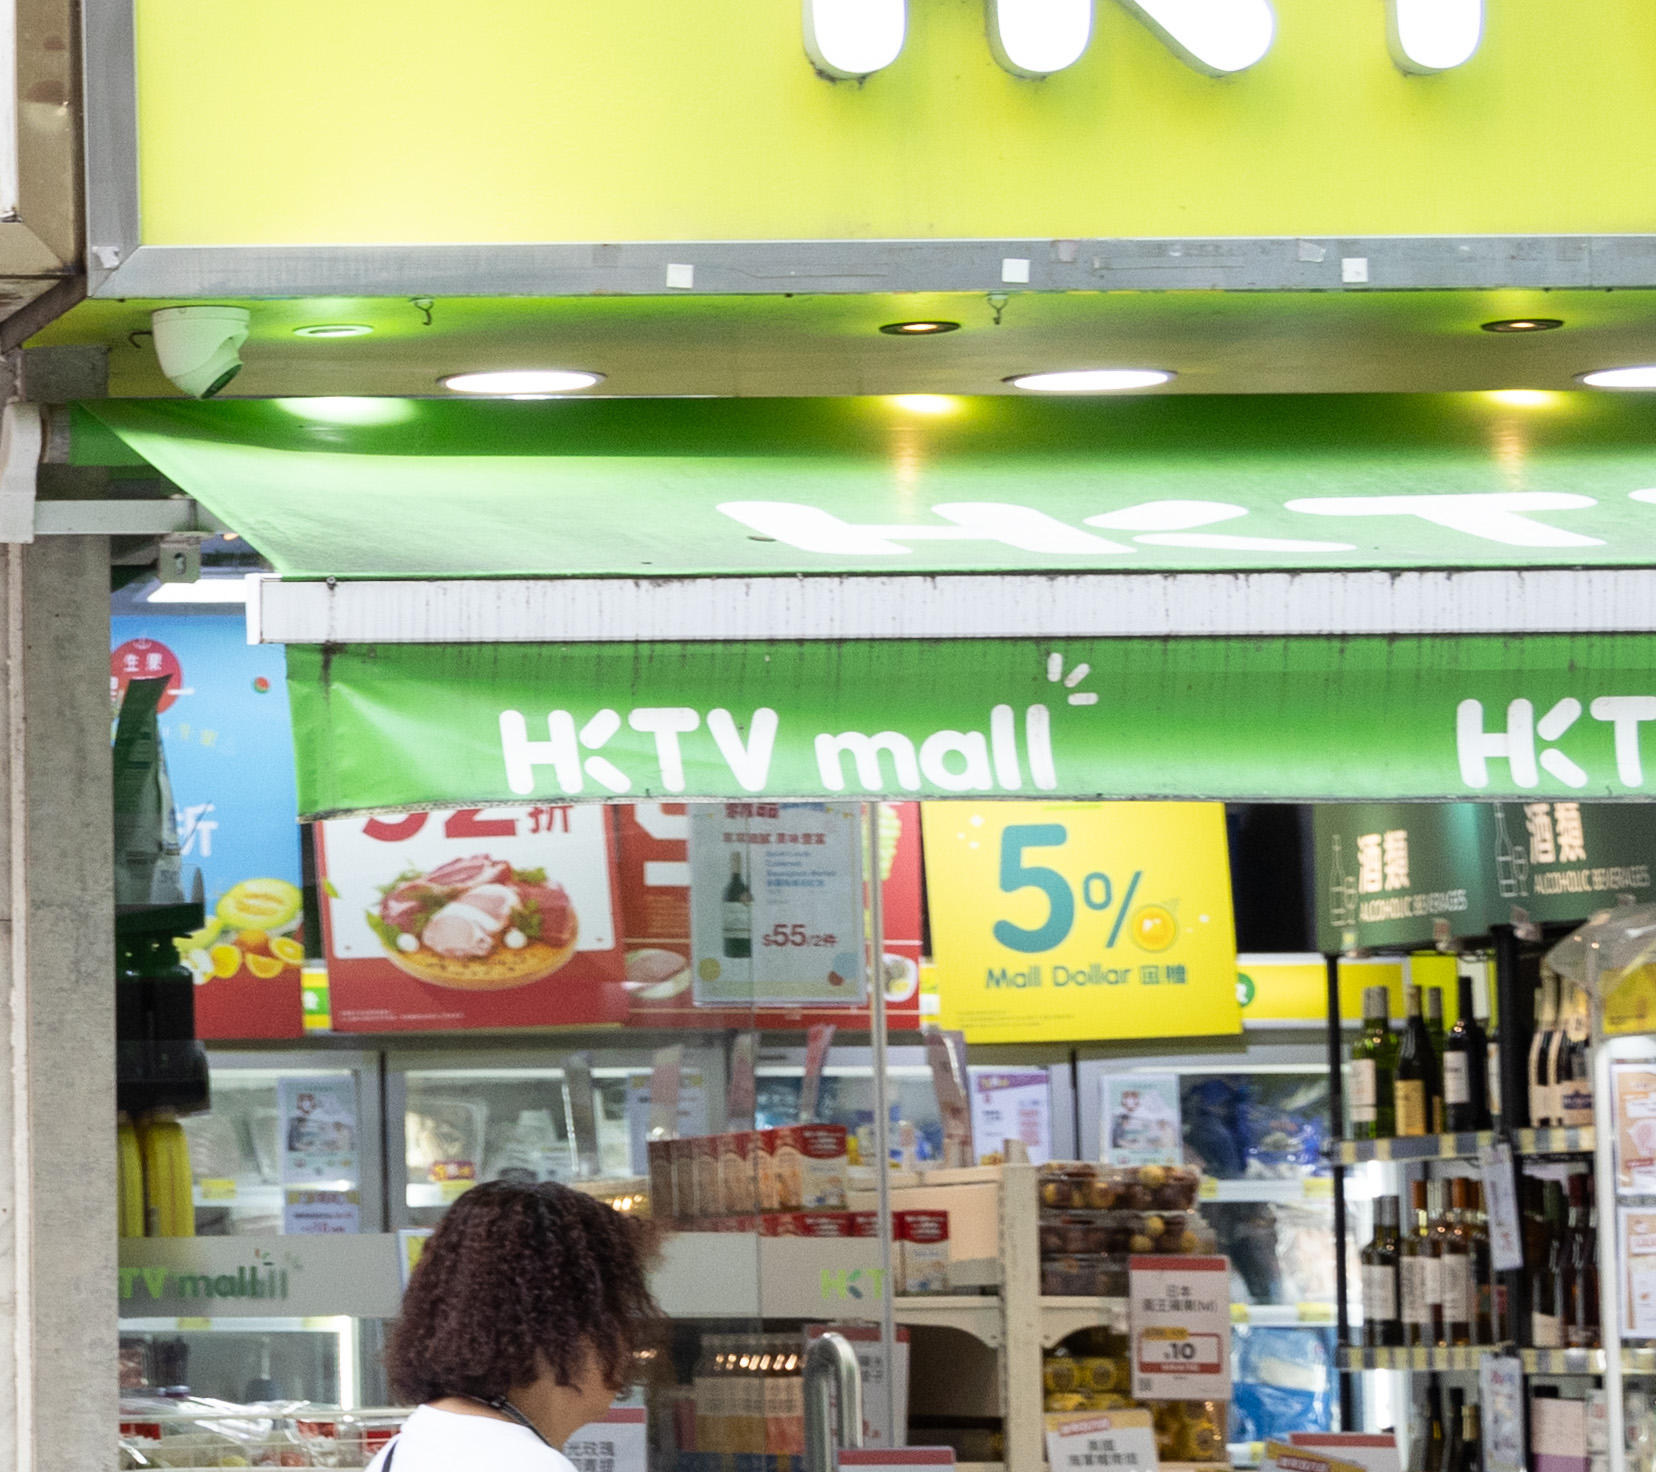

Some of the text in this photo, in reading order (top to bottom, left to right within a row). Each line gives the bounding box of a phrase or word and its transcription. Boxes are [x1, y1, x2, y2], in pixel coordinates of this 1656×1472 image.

[499, 703, 1056, 793] HKTV mall
[1357, 829, 1410, 895] 酒類
[986, 965, 1042, 989] Mall
[1053, 964, 1130, 988] Dollar
